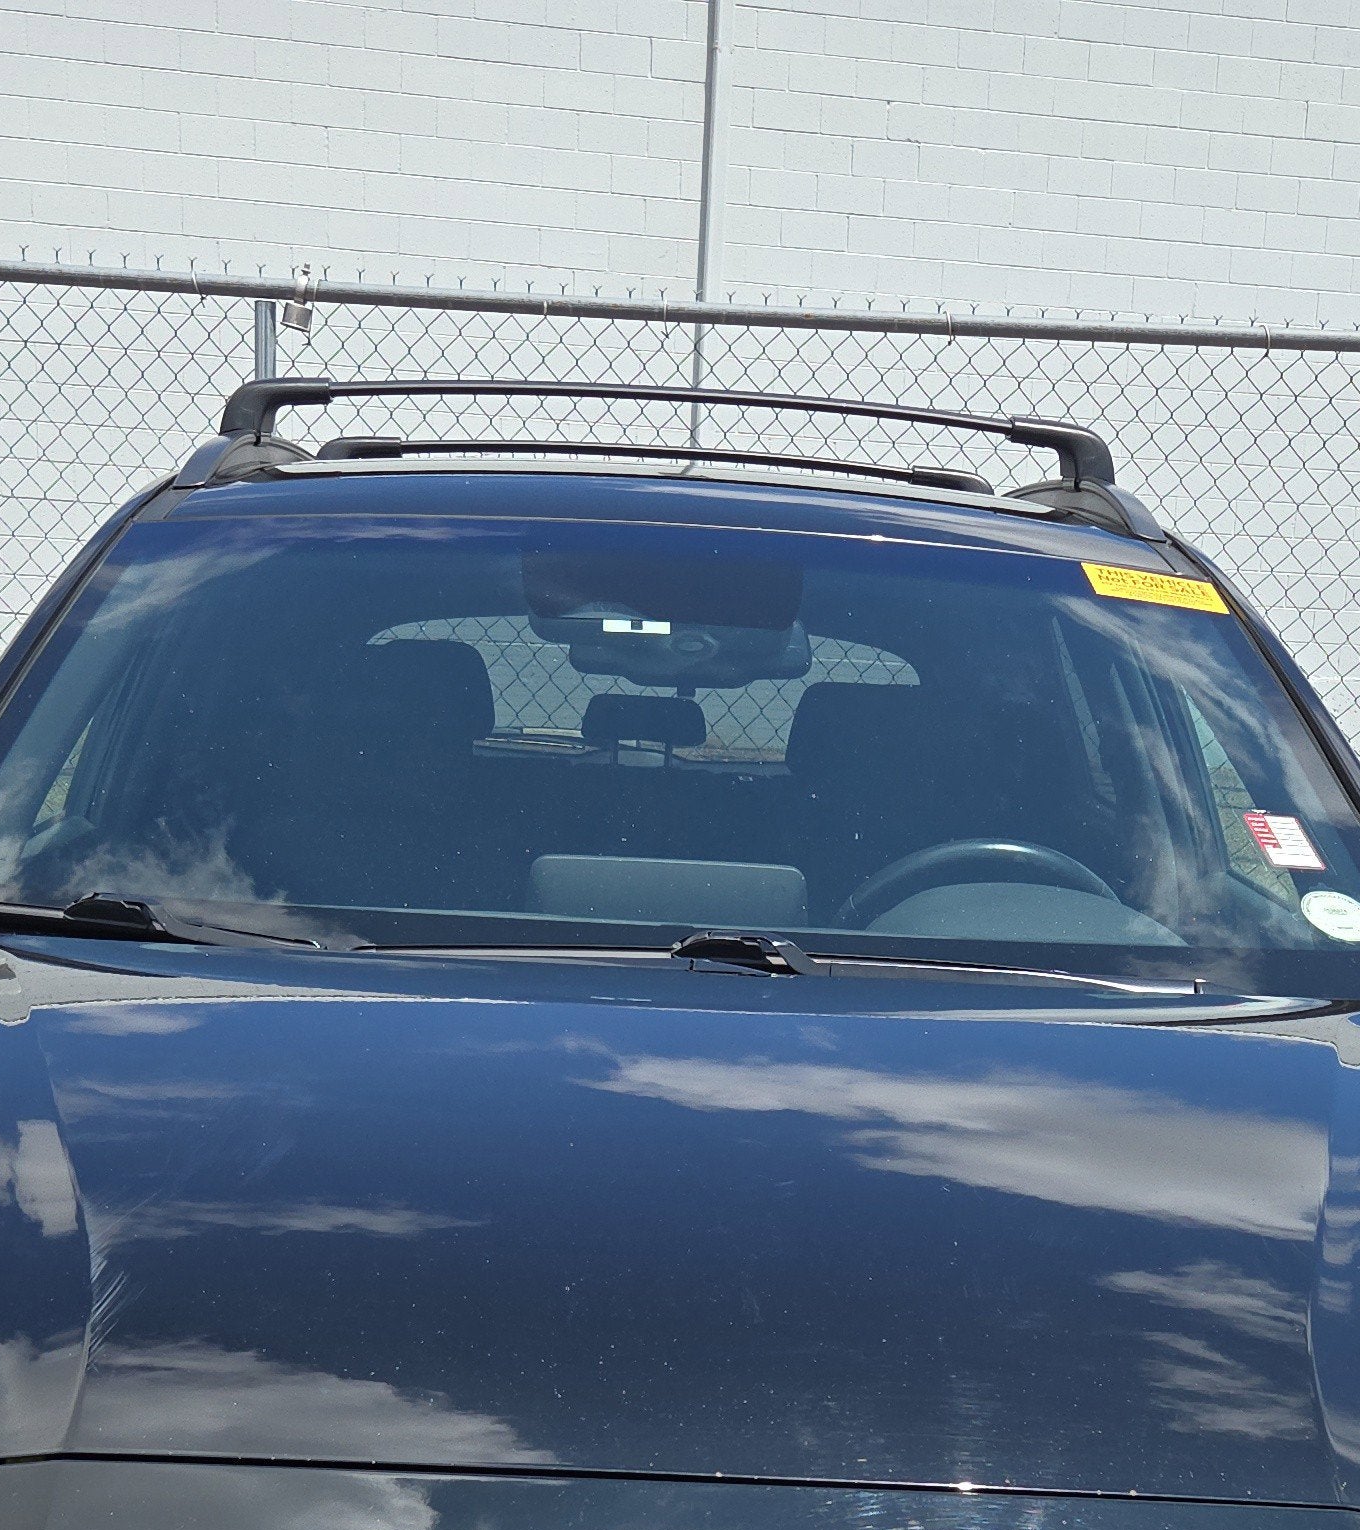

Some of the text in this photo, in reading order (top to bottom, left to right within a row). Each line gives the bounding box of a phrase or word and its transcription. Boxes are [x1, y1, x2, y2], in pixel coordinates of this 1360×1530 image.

[1096, 568, 1204, 590] THIS VEHICLE
[1132, 579, 1164, 590] FOR
[1169, 585, 1210, 597] SALE
